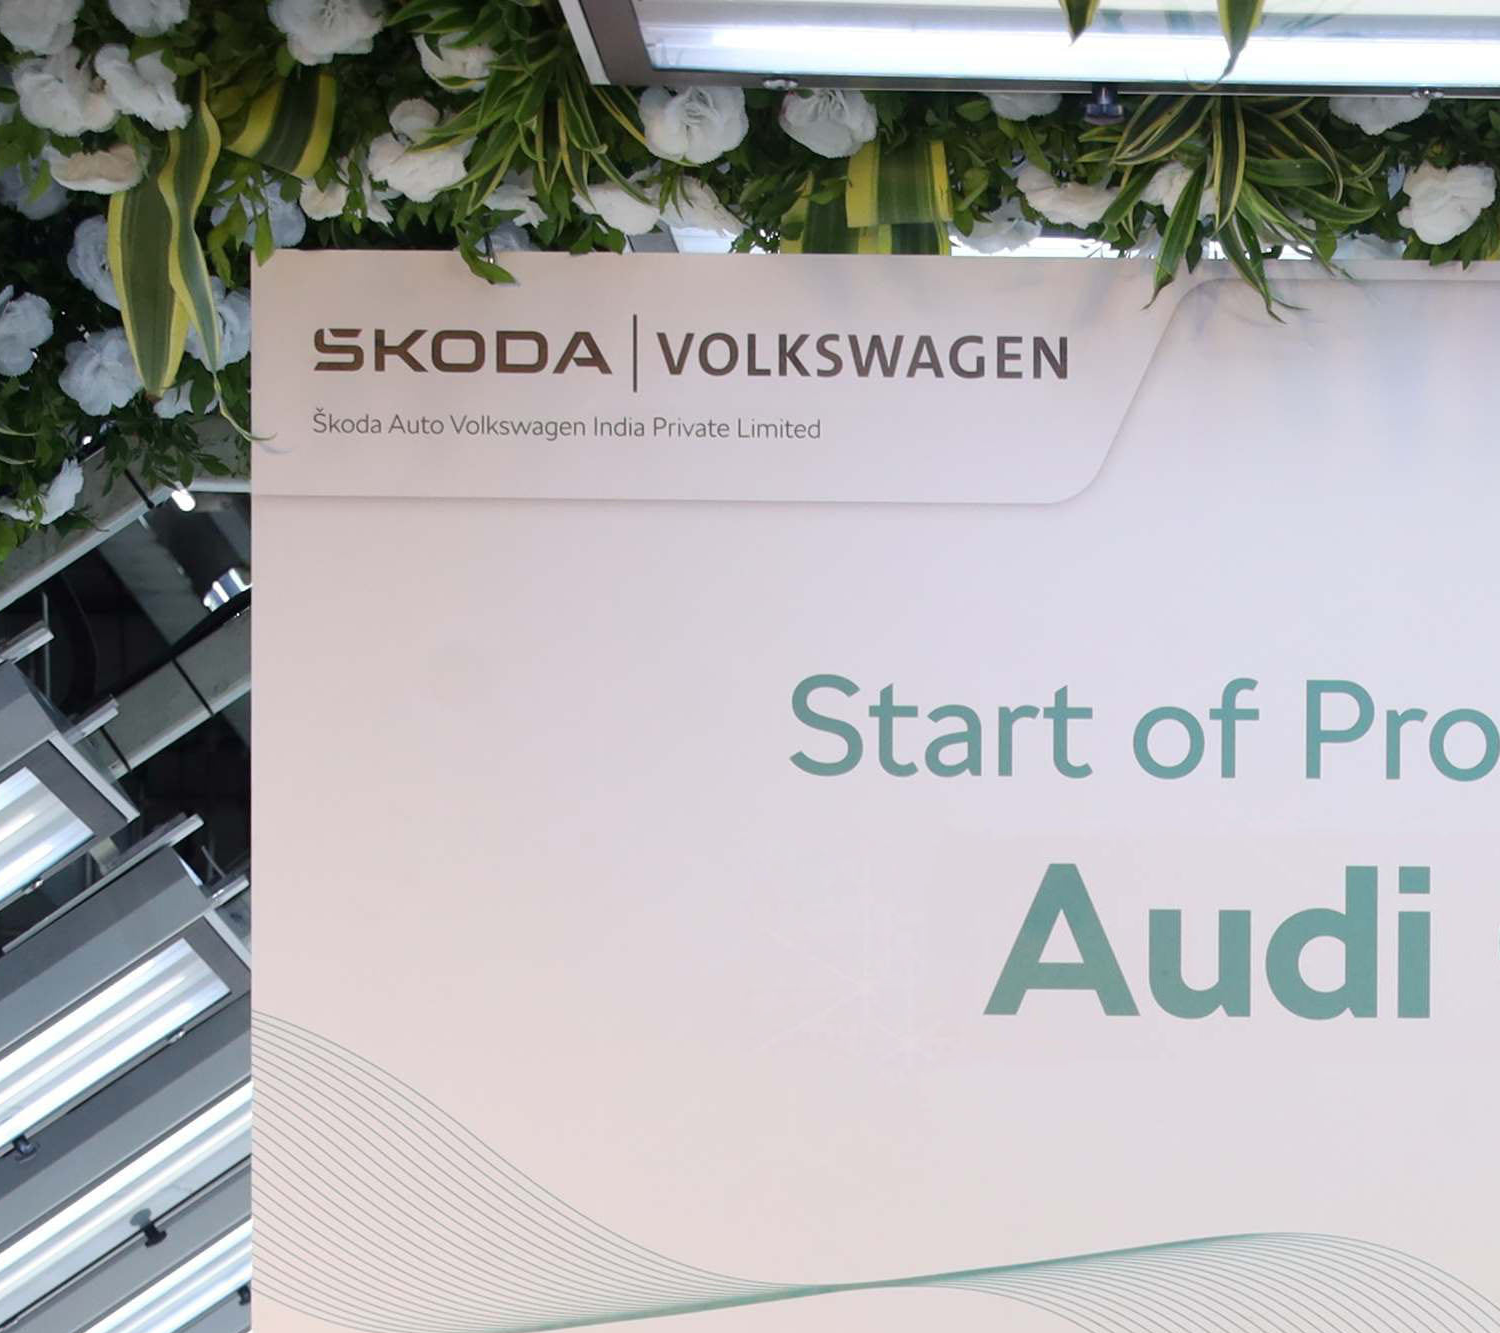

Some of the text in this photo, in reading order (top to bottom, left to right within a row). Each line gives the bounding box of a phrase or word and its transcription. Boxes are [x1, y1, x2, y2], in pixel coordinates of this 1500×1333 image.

[656, 332, 1068, 380] VOLKSWAGEN
[312, 407, 821, 442] Škoda Auto Volkswagen India Private Limited
[789, 673, 1094, 780] Start
[1132, 677, 1260, 780] of
[983, 863, 1431, 1021] Audi
